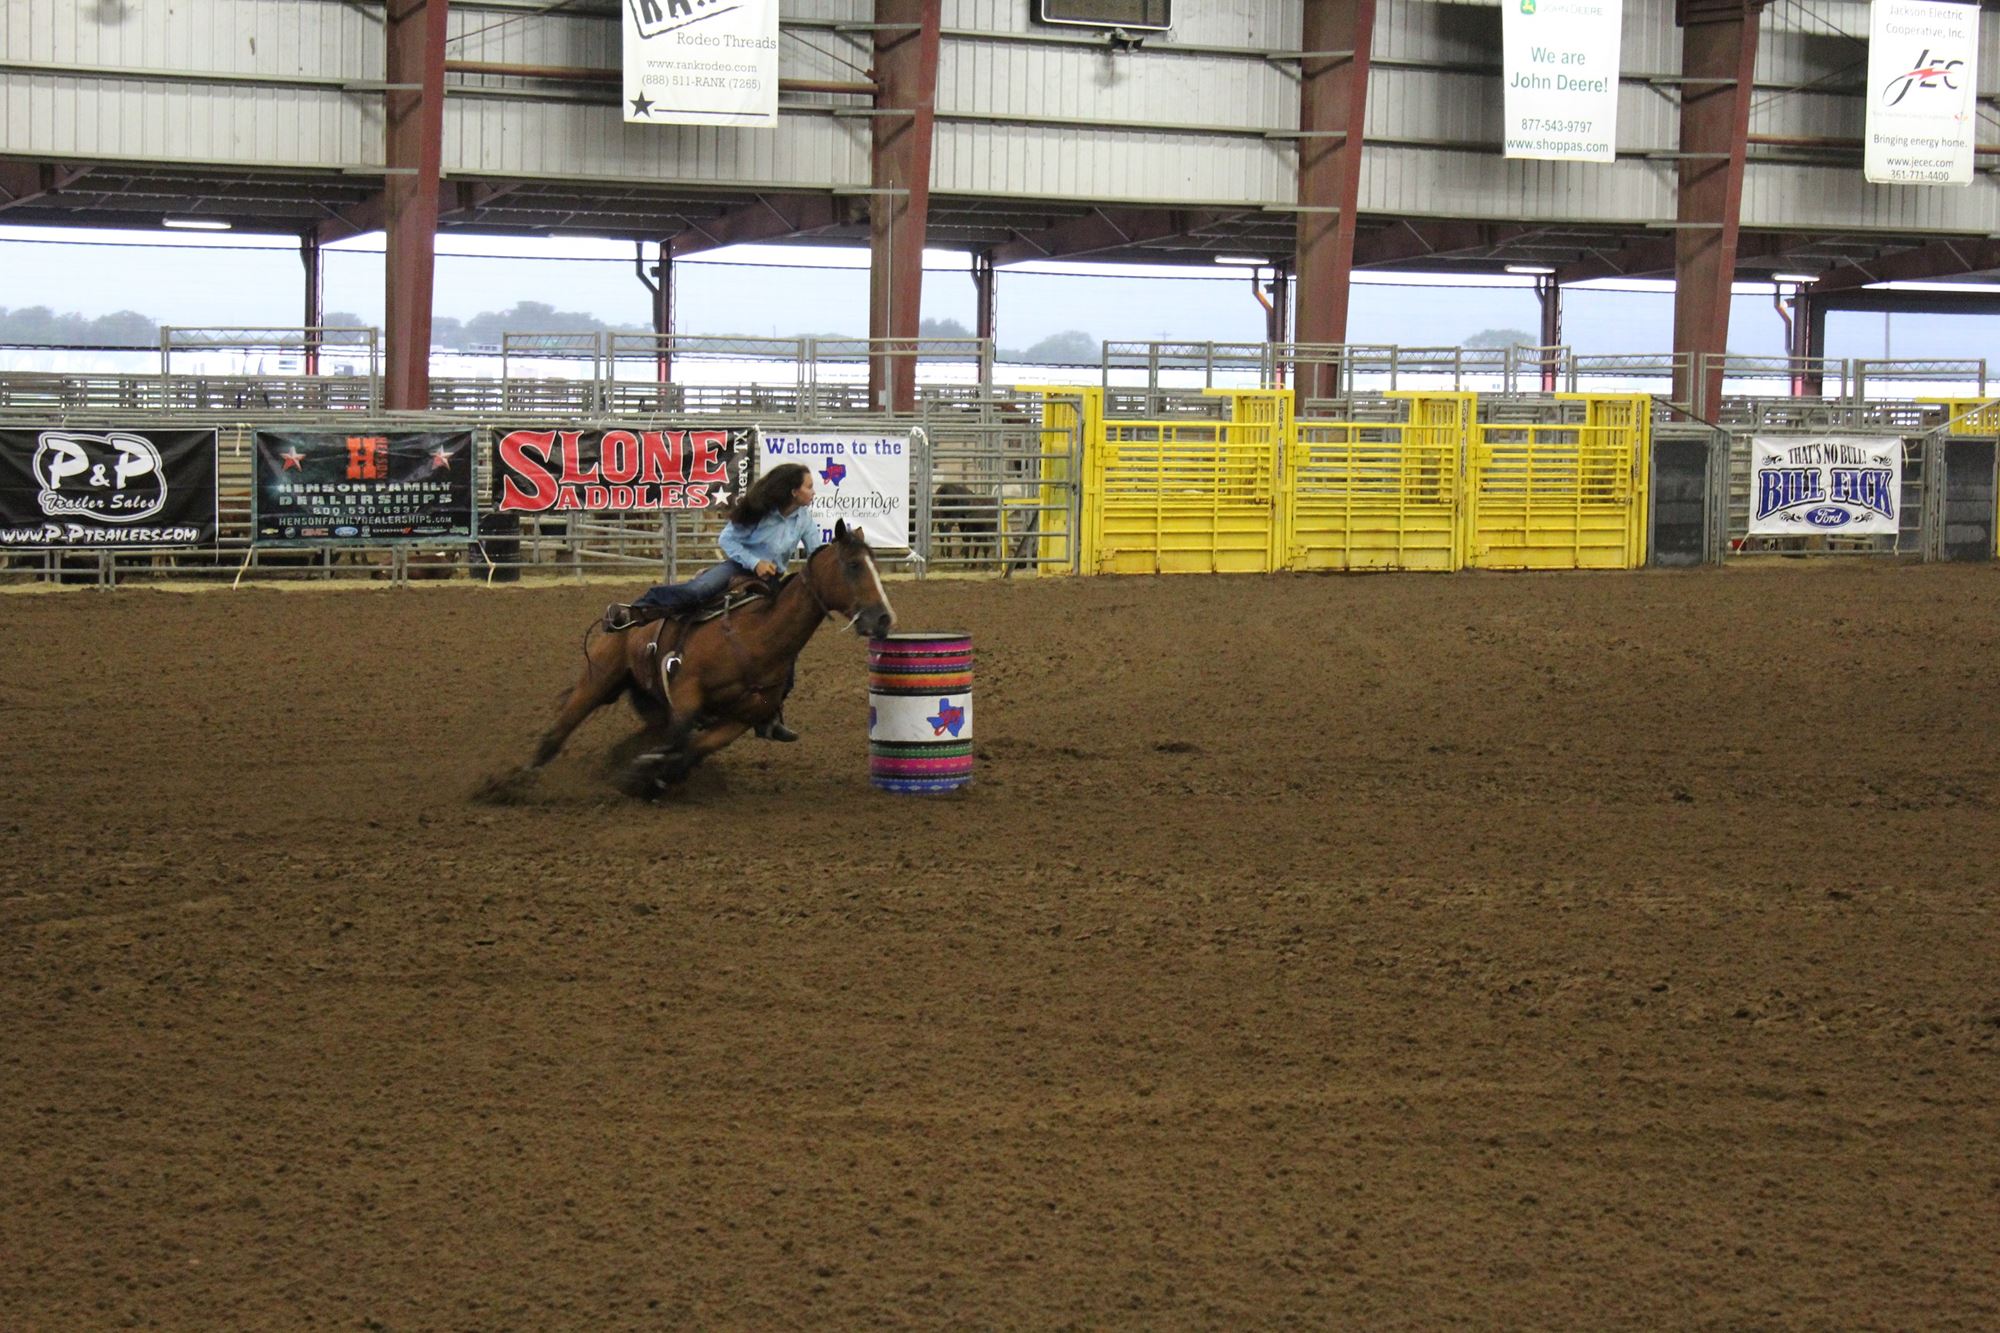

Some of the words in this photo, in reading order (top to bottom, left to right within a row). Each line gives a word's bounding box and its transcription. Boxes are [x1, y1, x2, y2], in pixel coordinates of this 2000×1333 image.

[1929, 8, 1963, 21] Electric
[1886, 22, 1946, 39] Cooperative,
[1948, 28, 1965, 39] Inc.
[677, 32, 720, 47] Rodeo
[724, 35, 777, 50] Threads
[1531, 46, 1556, 63] We
[1561, 52, 1586, 66] are
[647, 59, 757, 73] www.rankrodeo.com
[641, 74, 669, 87] (888)
[673, 75, 725, 89] 511-RANK
[728, 77, 761, 91] (7265)
[1510, 72, 1551, 89] John
[1557, 74, 1608, 93] Deere!
[1882, 49, 1964, 107] JEC
[1521, 118, 1592, 133] 877-543-9797
[1506, 138, 1609, 154] www.shoppas.com
[1873, 134, 1909, 148] Bringing
[1910, 138, 1939, 149] energy
[1941, 138, 1968, 148] home.
[1887, 157, 1954, 170] www.jecec.com
[1891, 169, 1949, 181] 361-771-4400
[733, 429, 748, 453] TX
[766, 438, 844, 455] Welcome
[852, 440, 867, 455] to
[874, 439, 902, 455] the
[1788, 443, 1821, 464] THAT'S
[1823, 443, 1838, 464] NO
[46, 439, 89, 490] P
[89, 463, 111, 487] &
[112, 439, 154, 490] P
[500, 430, 730, 511] SLONE
[279, 483, 367, 493] HENSON
[375, 482, 451, 492] FAMILY
[1757, 468, 1826, 520] BILL
[1830, 468, 1894, 520] FICK
[45, 495, 105, 510] Trailer
[110, 494, 156, 510] Sales
[280, 494, 452, 505] DEALERSHIPS
[811, 488, 900, 514] rackenridge
[279, 516, 452, 526] HENSONFAMILYDEALERSHIPS.COM
[1814, 509, 1842, 525] Ford
